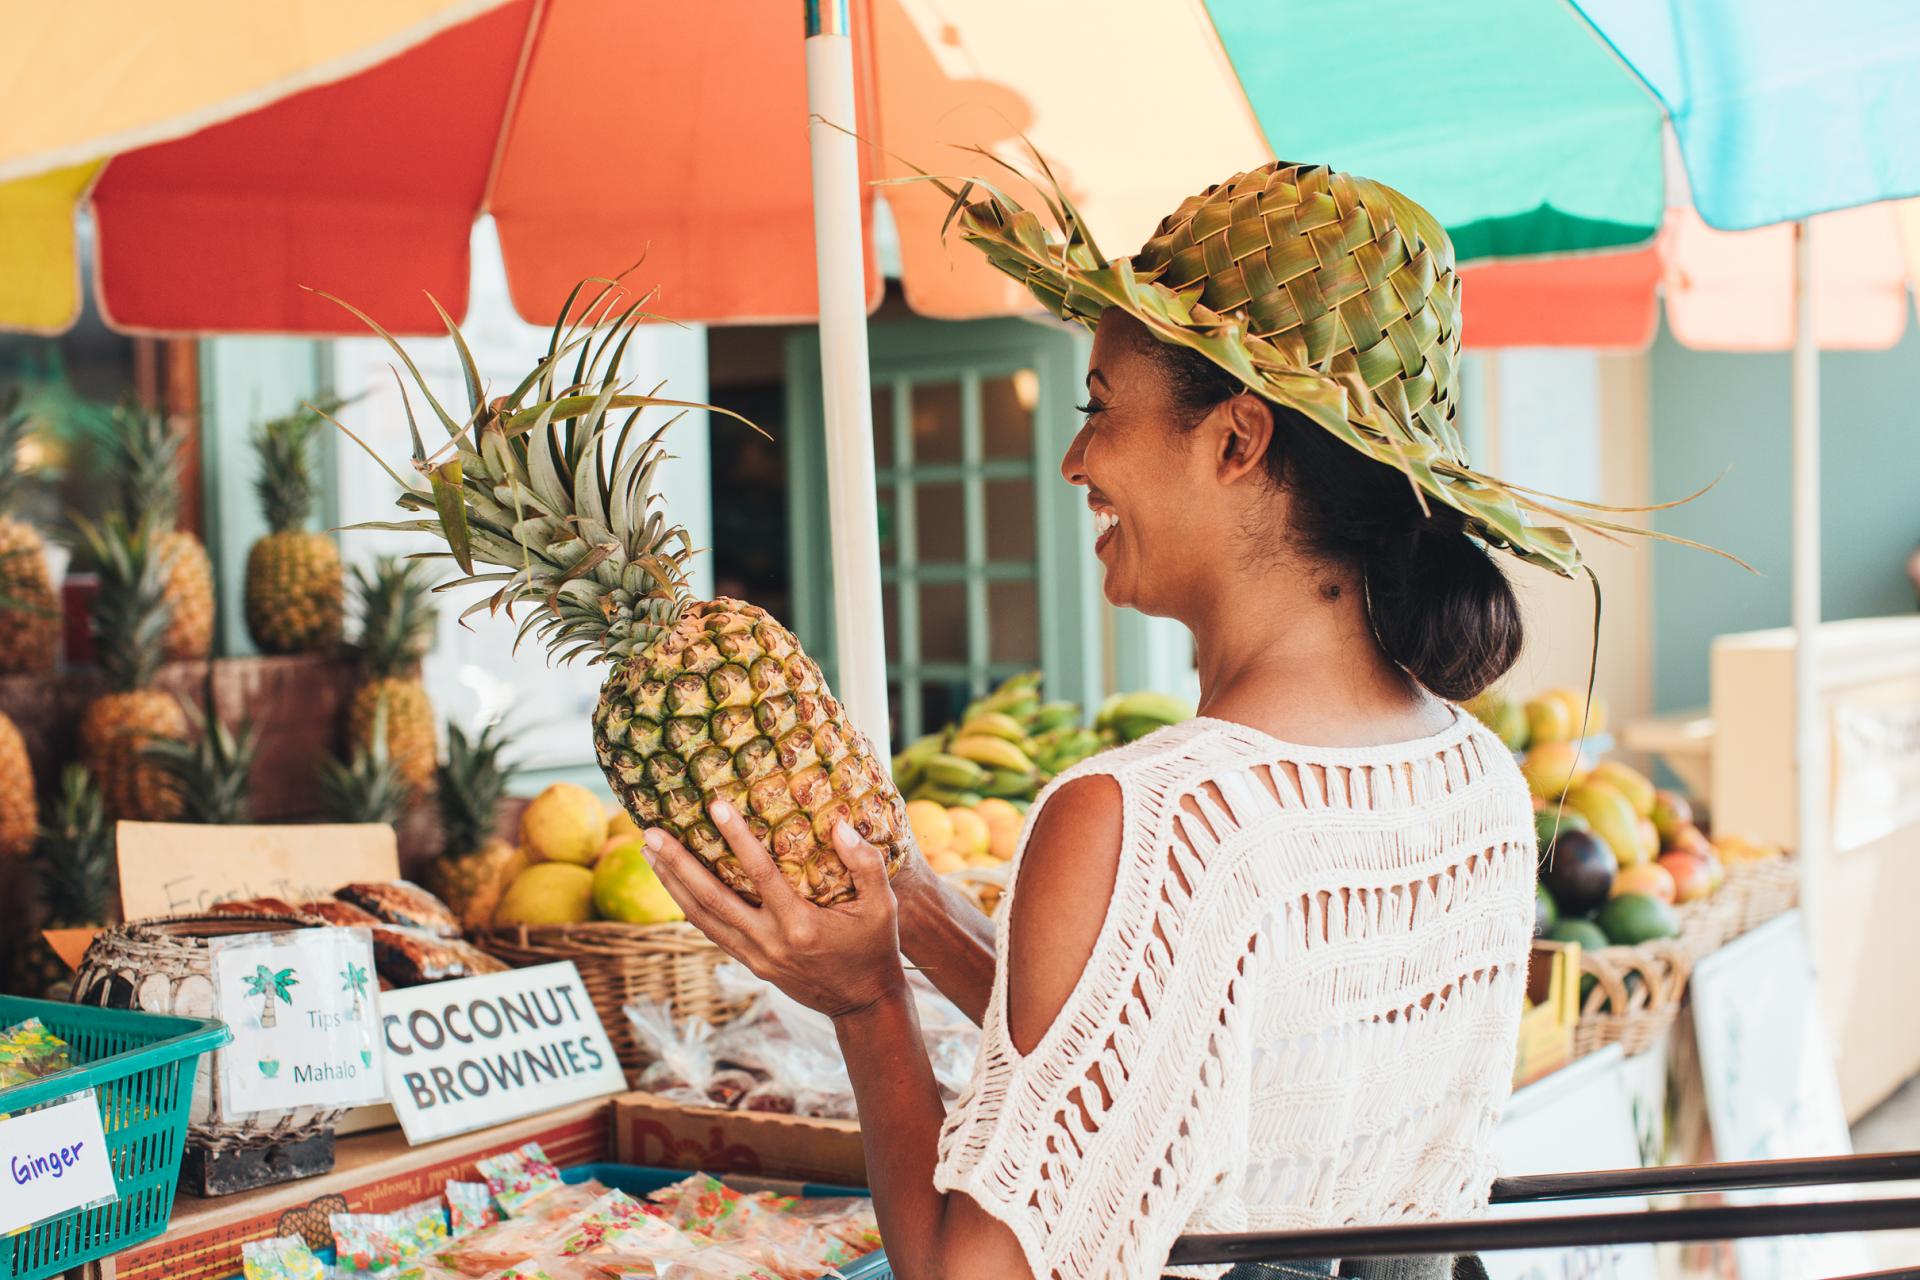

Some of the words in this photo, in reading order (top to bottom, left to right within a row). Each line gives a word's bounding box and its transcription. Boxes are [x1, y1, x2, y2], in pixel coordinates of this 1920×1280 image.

[306, 1009, 341, 1032] Tips
[383, 985, 580, 1056] COCONUT
[294, 1060, 356, 1083] Mahalo
[403, 1036, 603, 1110] BROWNIES
[11, 1141, 84, 1185] Ginger
